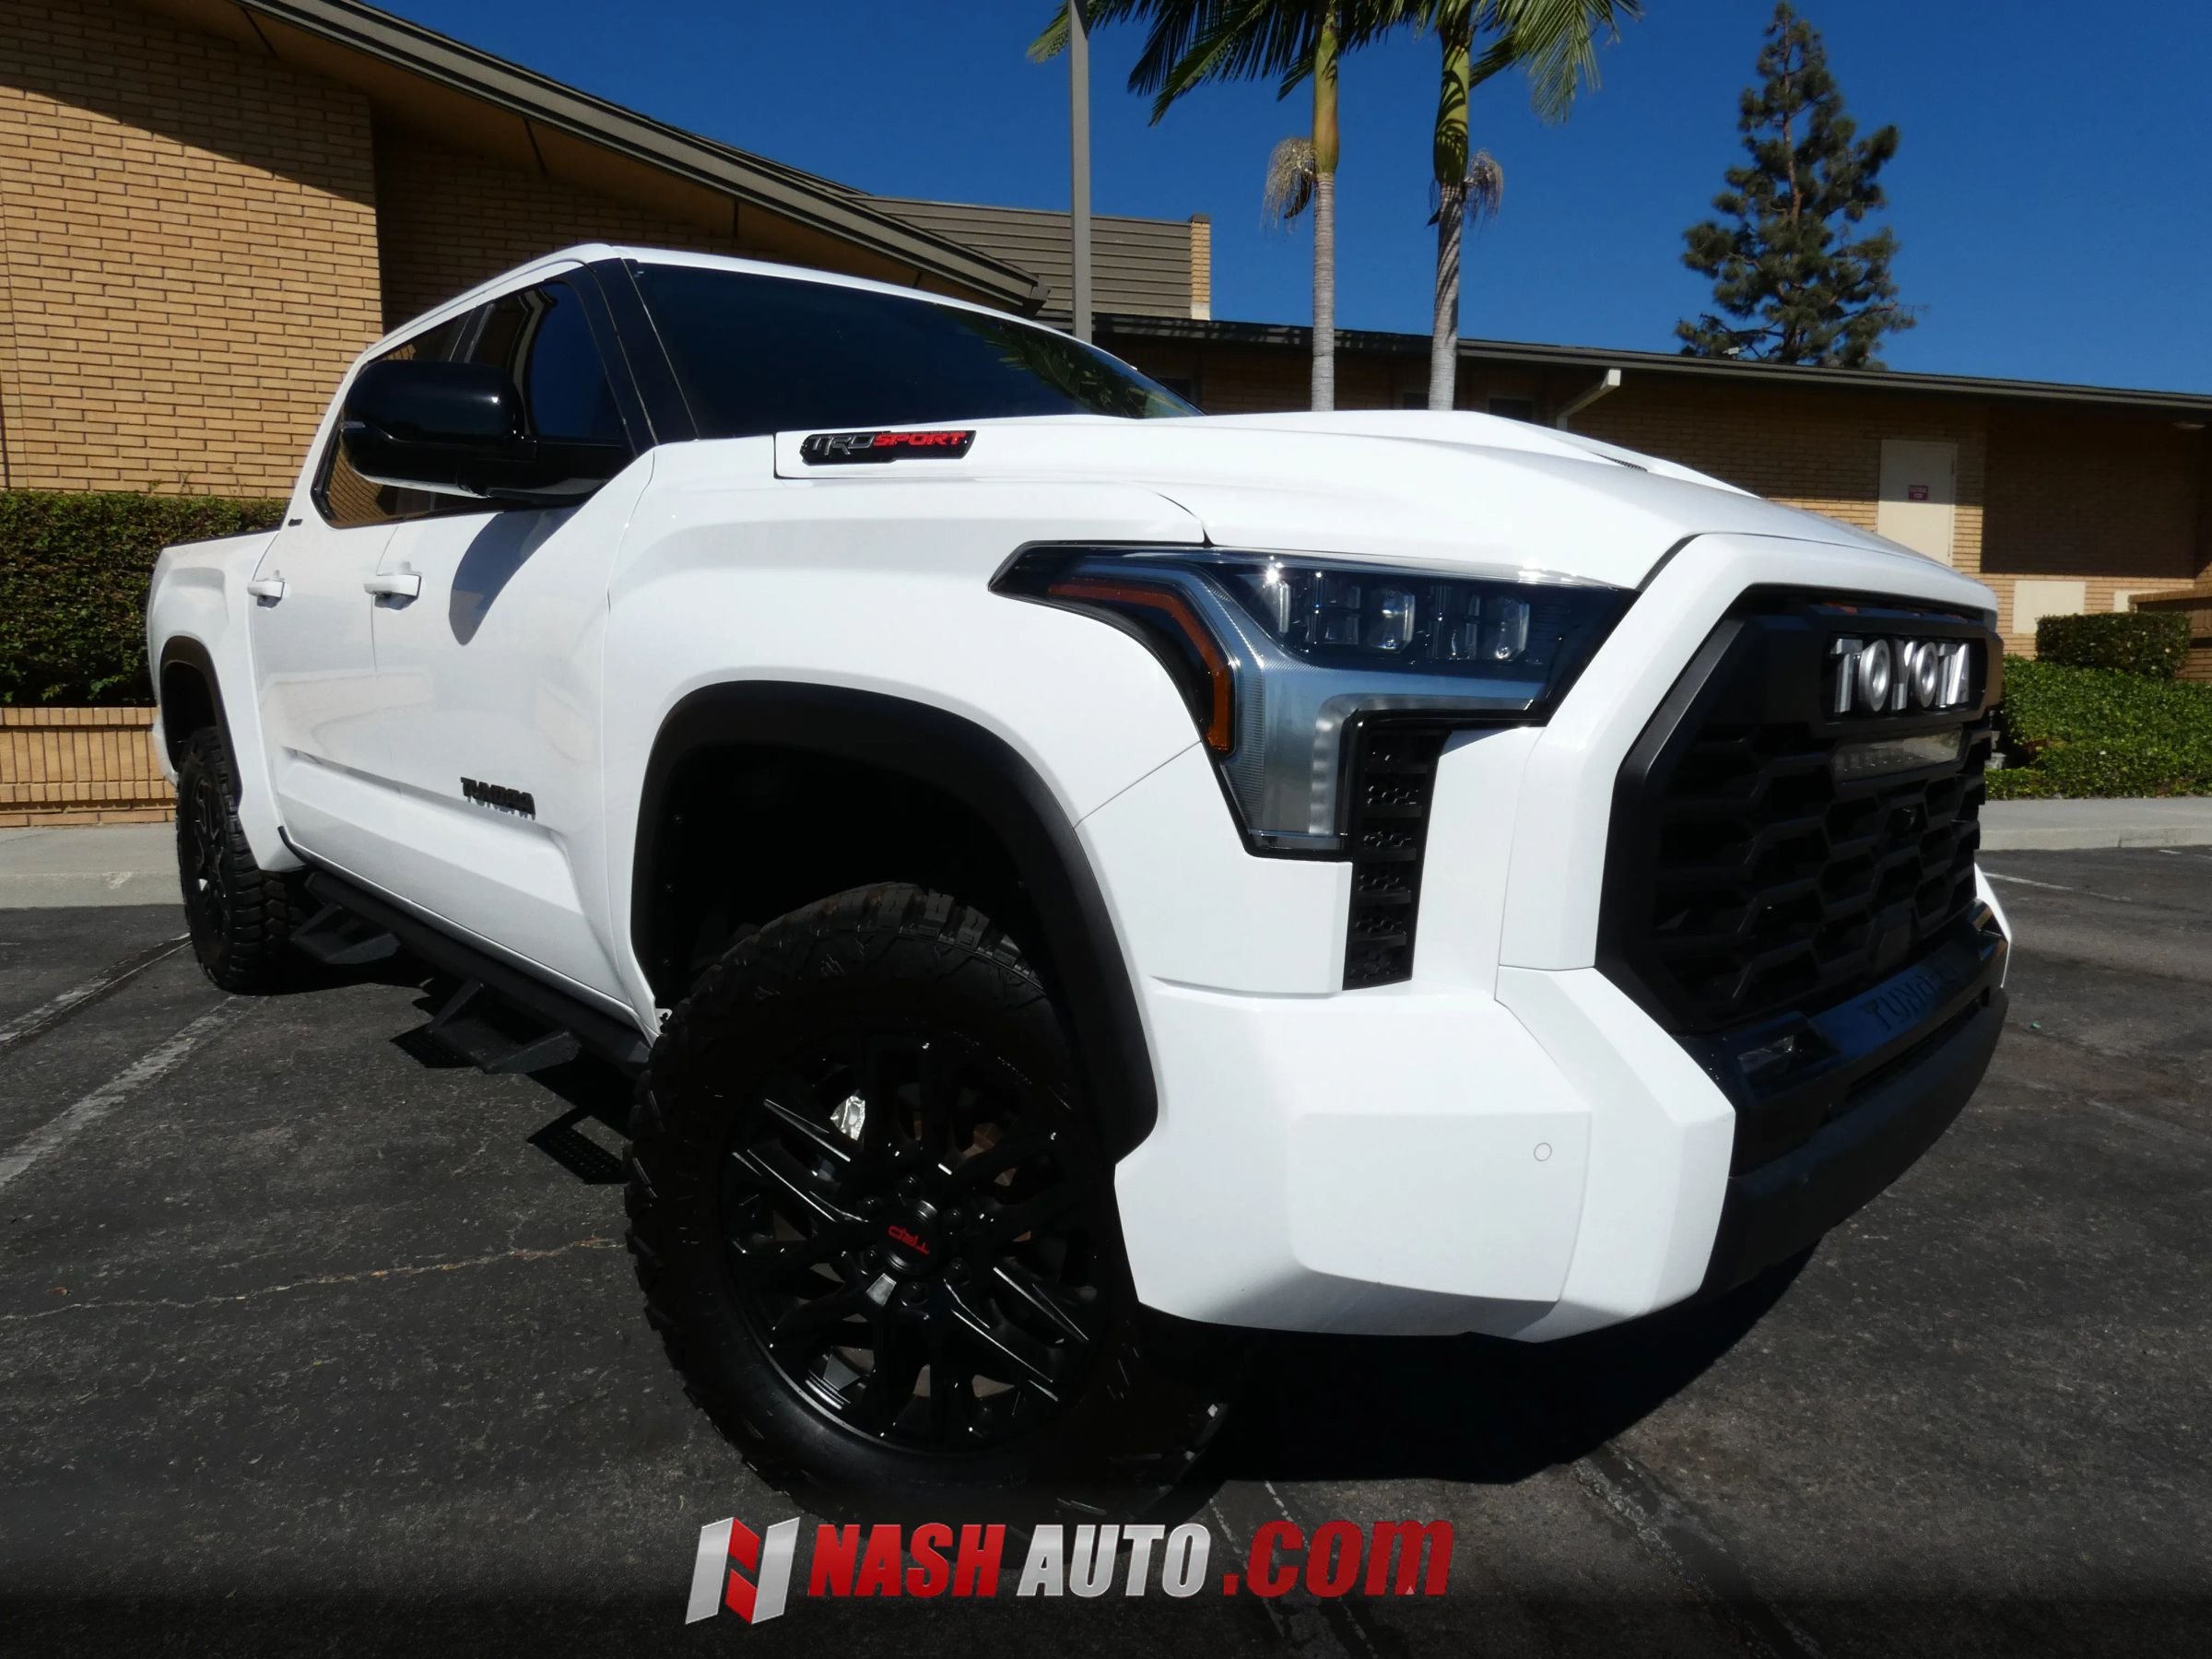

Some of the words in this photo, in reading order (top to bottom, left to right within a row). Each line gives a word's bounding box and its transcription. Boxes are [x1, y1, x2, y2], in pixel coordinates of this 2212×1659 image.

[808, 433, 876, 456] TRD
[873, 430, 967, 448] SPORT
[1830, 638, 1971, 712] TOYOTA
